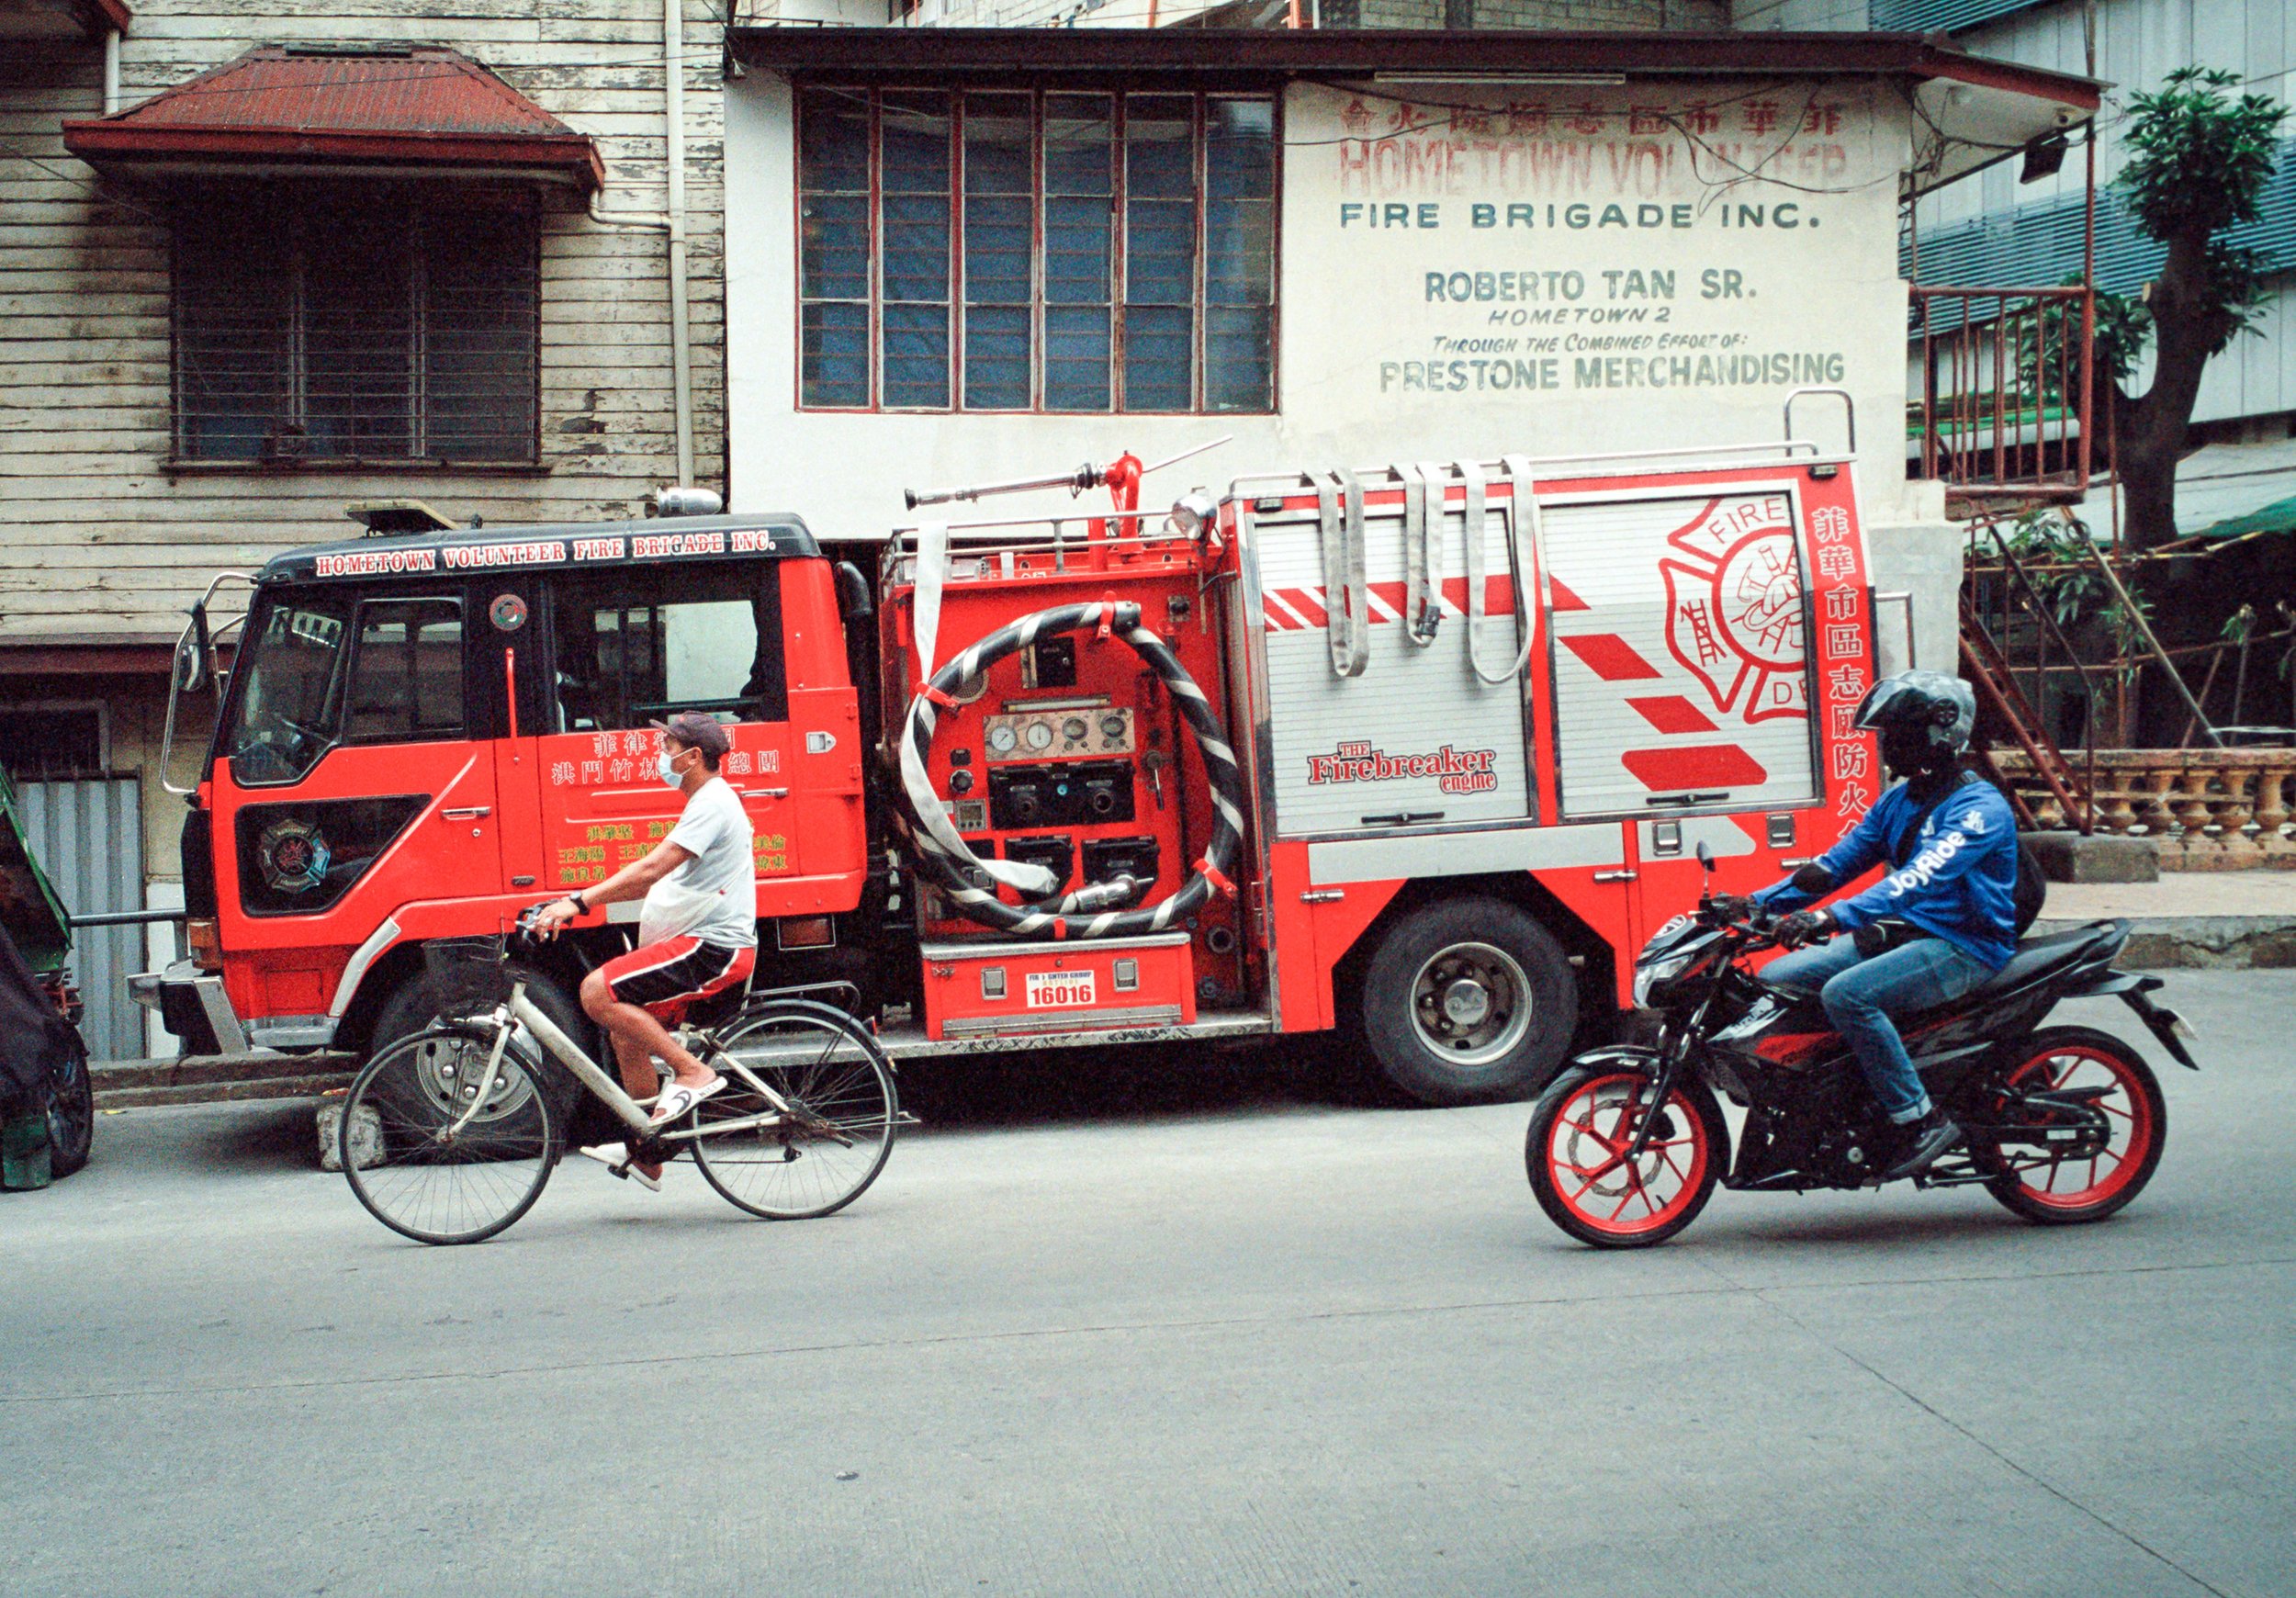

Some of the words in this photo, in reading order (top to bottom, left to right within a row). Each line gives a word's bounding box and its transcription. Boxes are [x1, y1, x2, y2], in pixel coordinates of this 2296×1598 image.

[1340, 138, 1592, 197] HOMETOWN
[1341, 203, 1440, 229] FIRE
[1471, 203, 1693, 229] BRIGADE
[1721, 203, 1820, 229] INC.
[1424, 270, 1585, 302] ROBERTO
[1601, 269, 1676, 300] TAN
[1700, 268, 1757, 300] SR.
[1488, 308, 1649, 326] HOMETOWN
[1654, 306, 1671, 323] 2
[1379, 359, 1560, 394] PRESTONE
[1574, 352, 1845, 390] MERCHANDISING
[1707, 497, 1786, 545] FIRE
[316, 550, 435, 577] HOMETOWN
[443, 540, 566, 568] VOLUNTEER
[573, 537, 625, 561] FIRE
[632, 532, 725, 558] BRIGADE
[731, 530, 777, 552] INC.
[1811, 506, 1873, 839] 菲華市區志願防火
[1308, 746, 1495, 784] Firebreaker
[1339, 741, 1370, 758] THE
[1441, 772, 1496, 793] engine
[1888, 831, 1966, 897] JoyRide
[1030, 984, 1092, 1006] 16016
